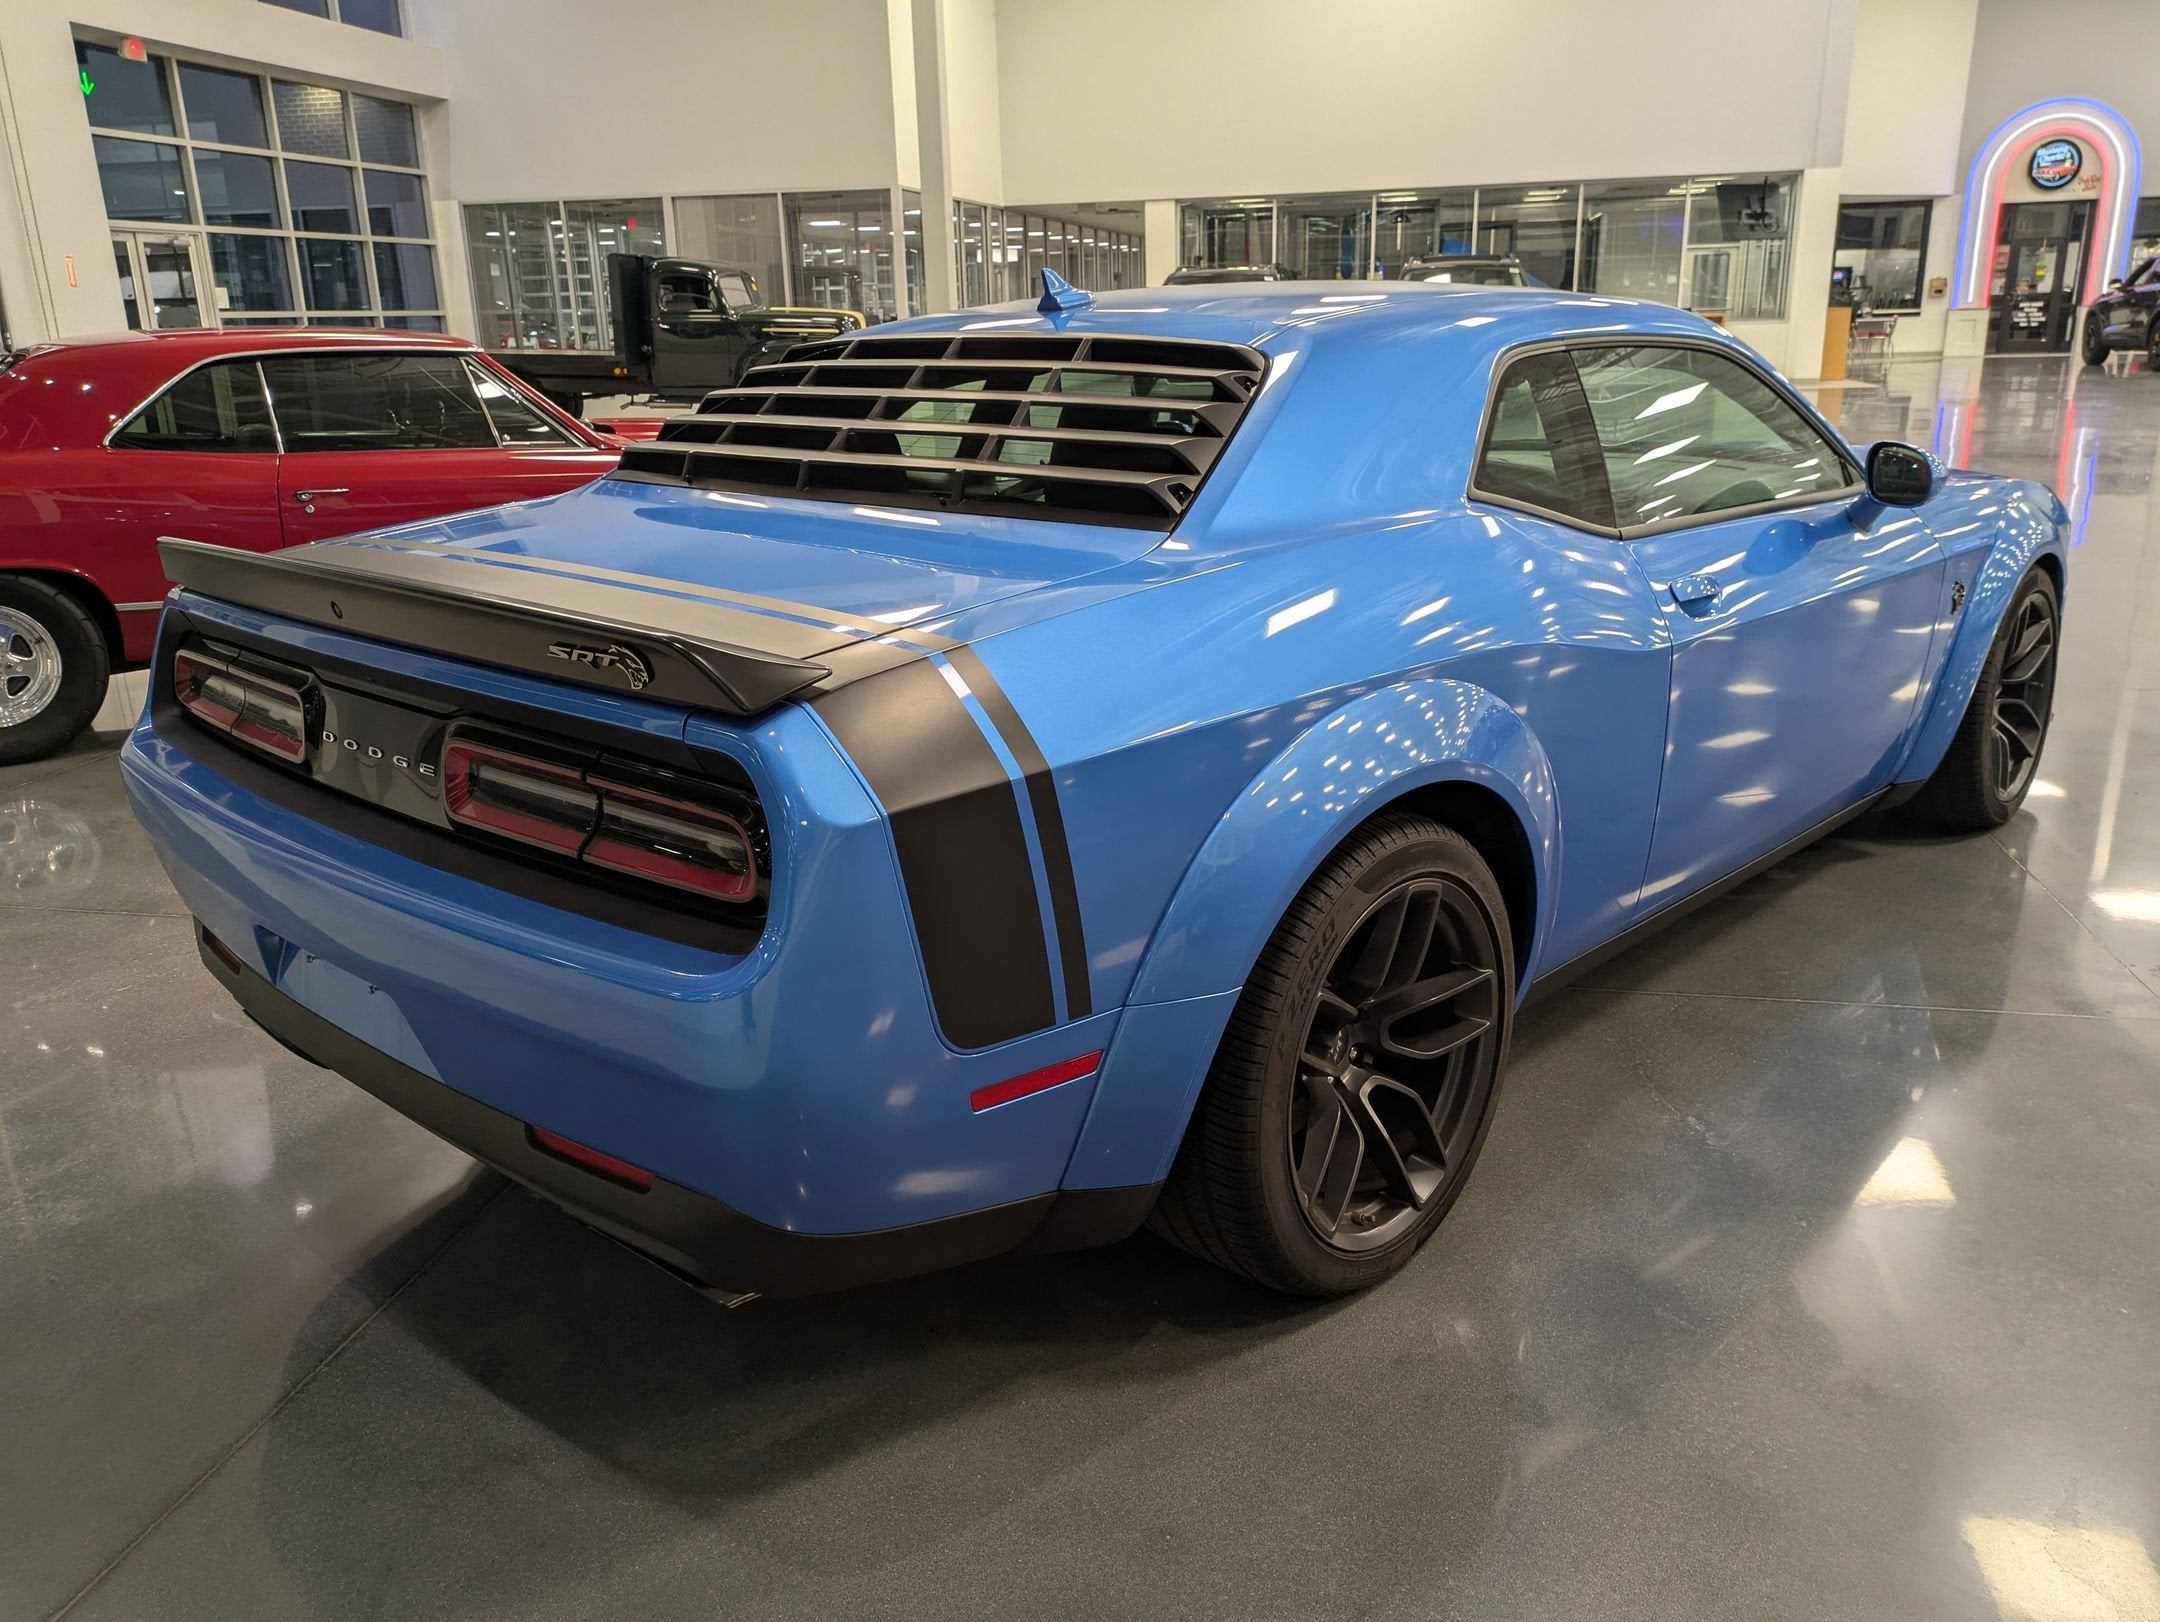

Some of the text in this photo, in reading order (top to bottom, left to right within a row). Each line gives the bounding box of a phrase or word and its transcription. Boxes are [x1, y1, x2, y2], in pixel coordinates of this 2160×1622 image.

[547, 645, 620, 671] SRT
[322, 731, 436, 777] DODGE
[1286, 917, 1336, 1023] ZERO
